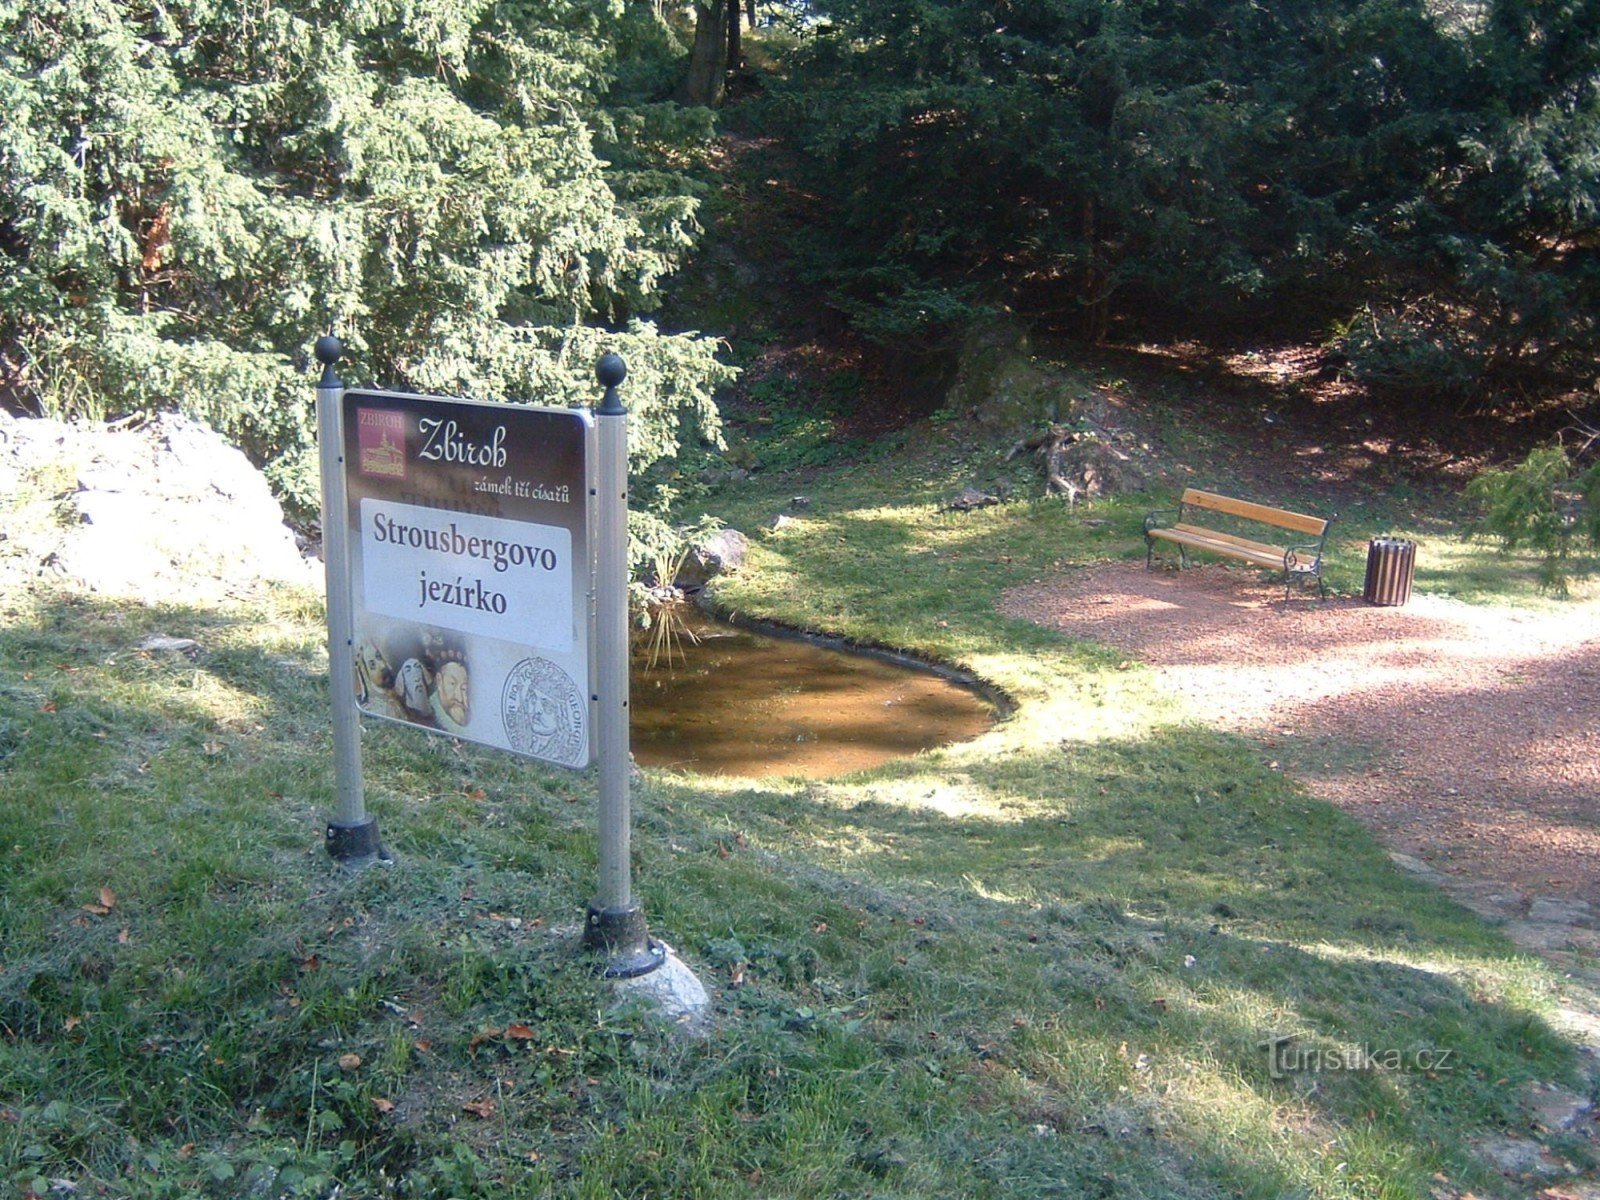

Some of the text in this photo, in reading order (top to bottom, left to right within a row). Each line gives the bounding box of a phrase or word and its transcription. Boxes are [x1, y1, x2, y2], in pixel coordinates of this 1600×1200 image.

[360, 411, 402, 429] ZBIROH
[418, 417, 507, 468] Zbiroh
[474, 475, 570, 504] zámek tří císařů
[373, 512, 557, 573] Strousbergovo
[418, 571, 508, 615] jezírko
